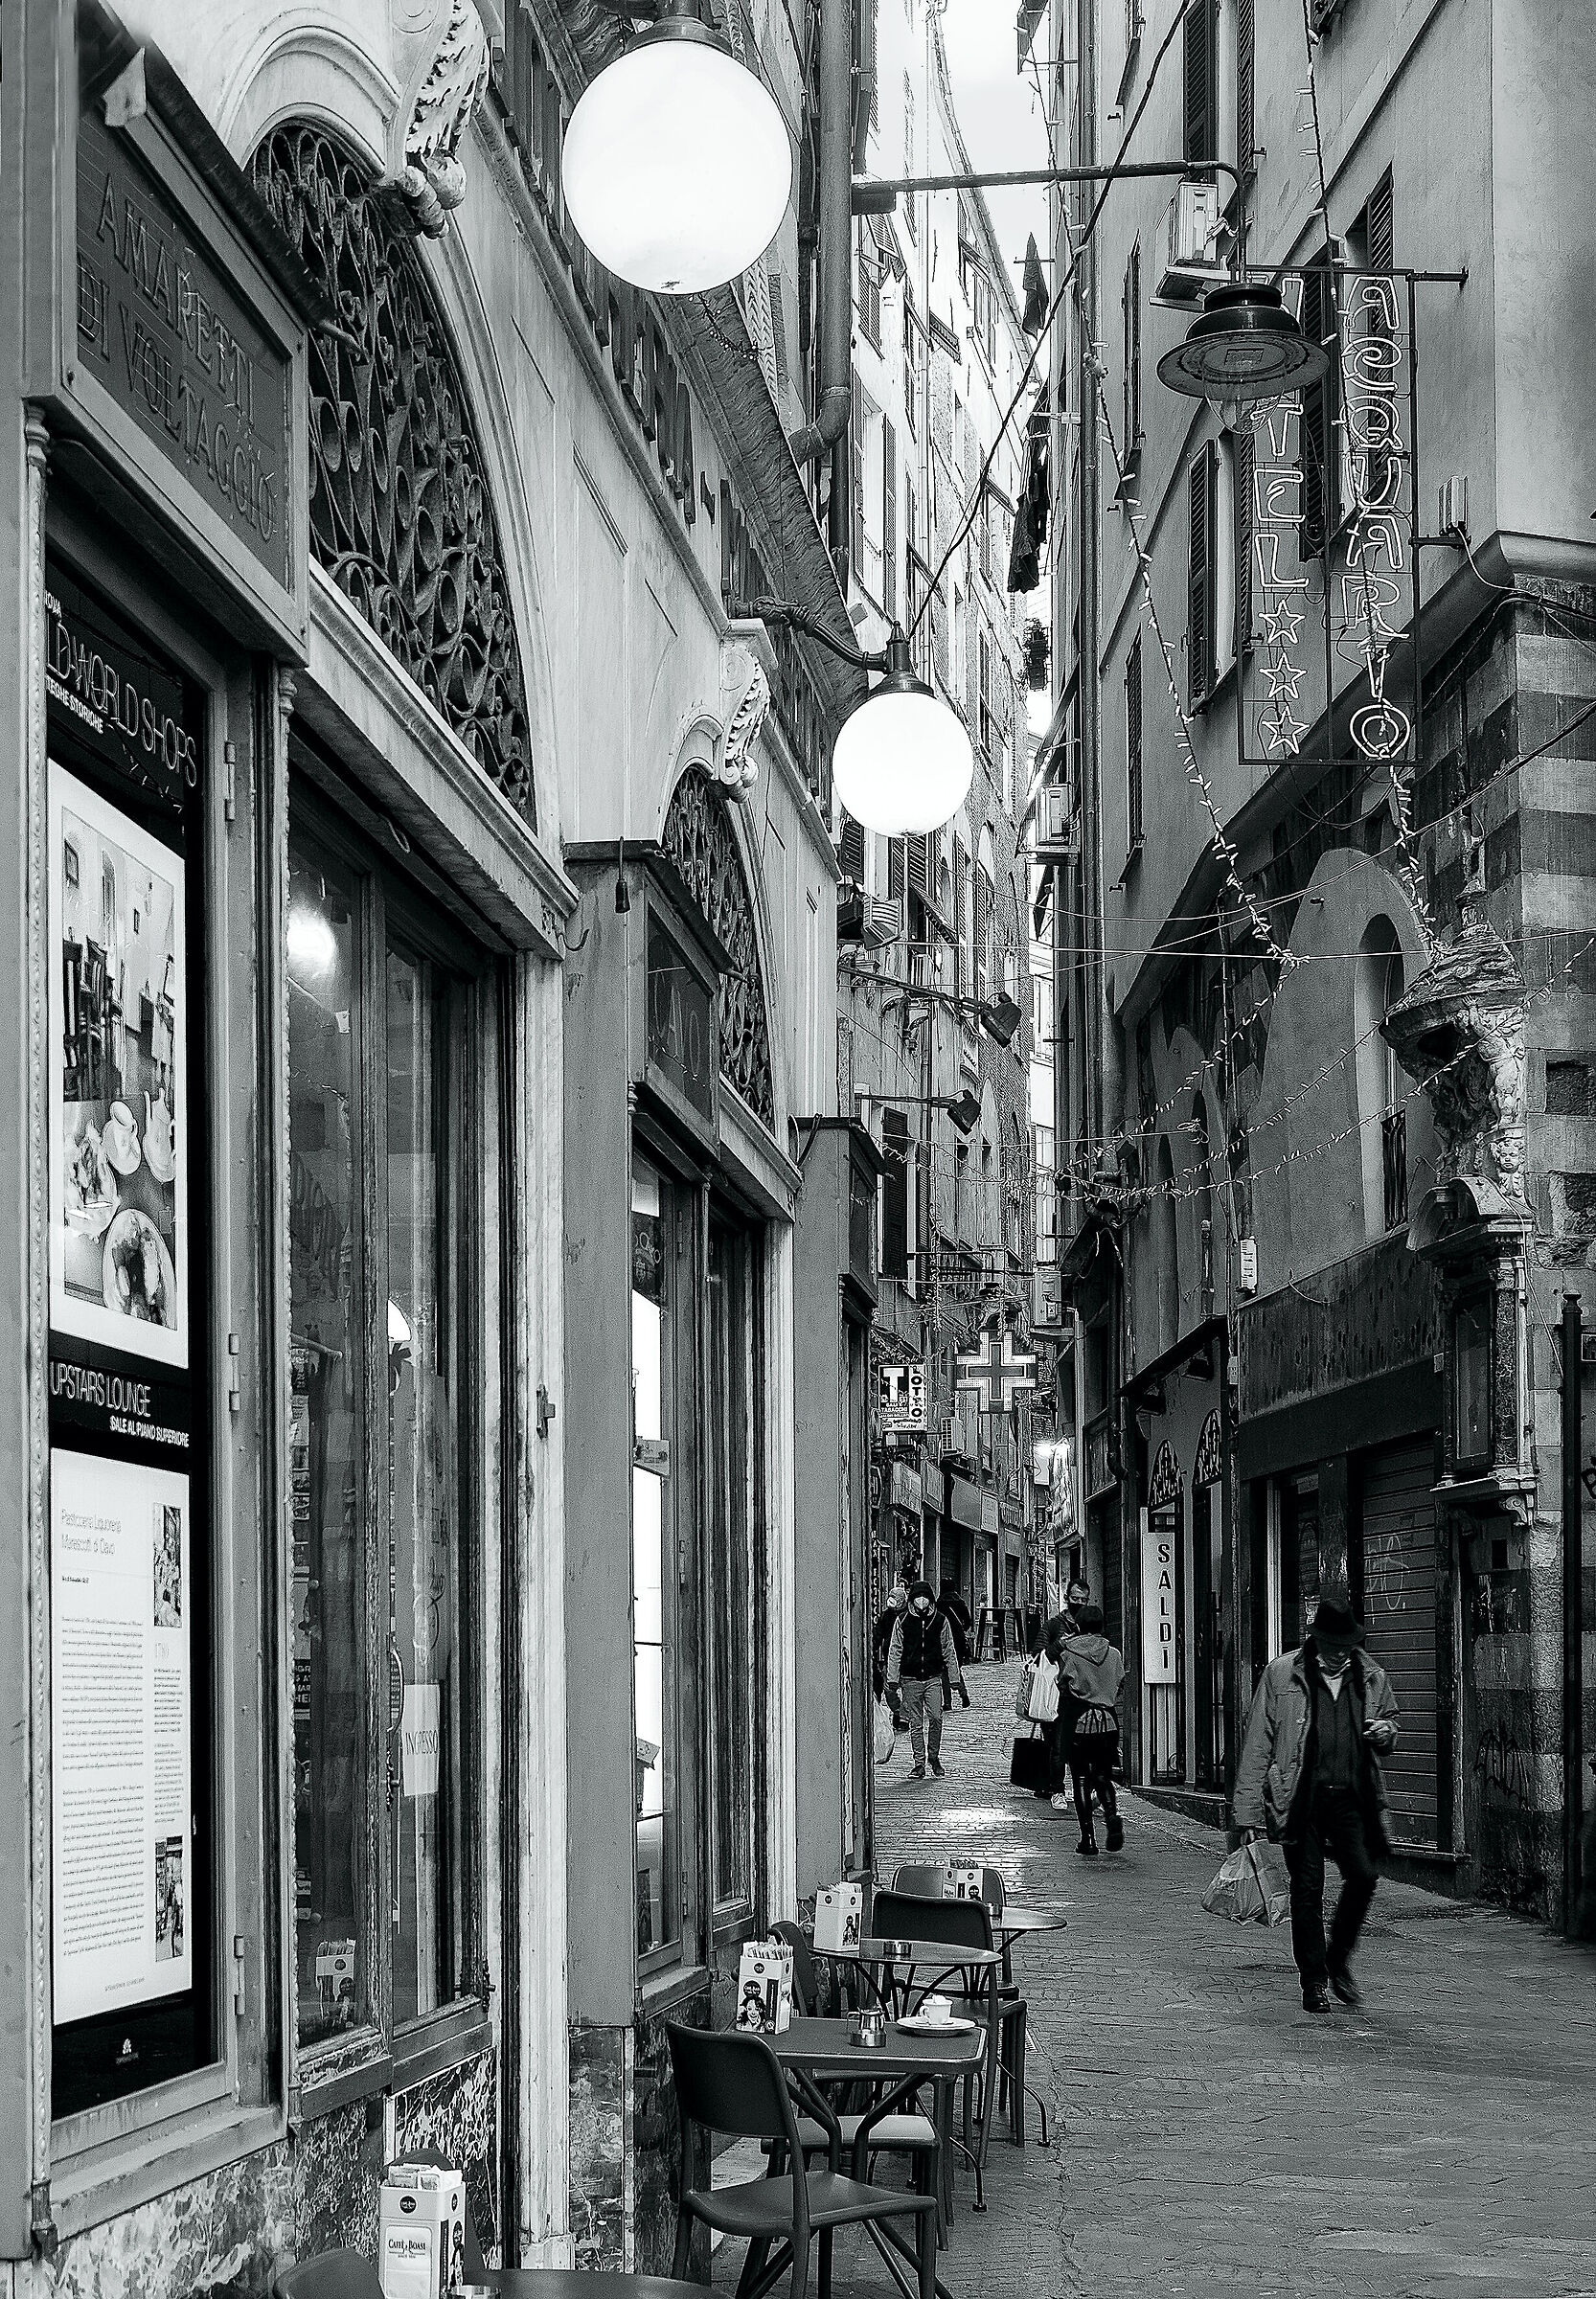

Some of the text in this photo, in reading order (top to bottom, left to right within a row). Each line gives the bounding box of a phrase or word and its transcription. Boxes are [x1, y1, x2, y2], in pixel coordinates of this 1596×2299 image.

[97, 173, 255, 427] AMARETTI
[79, 255, 275, 542] DI VOLTAGGIO
[141, 698, 197, 787] SHOPS
[106, 1377, 151, 1418] LOUNGE
[109, 1415, 127, 1433] SALE
[883, 1368, 903, 1403] T
[1157, 1544, 1172, 1670] SALDI
